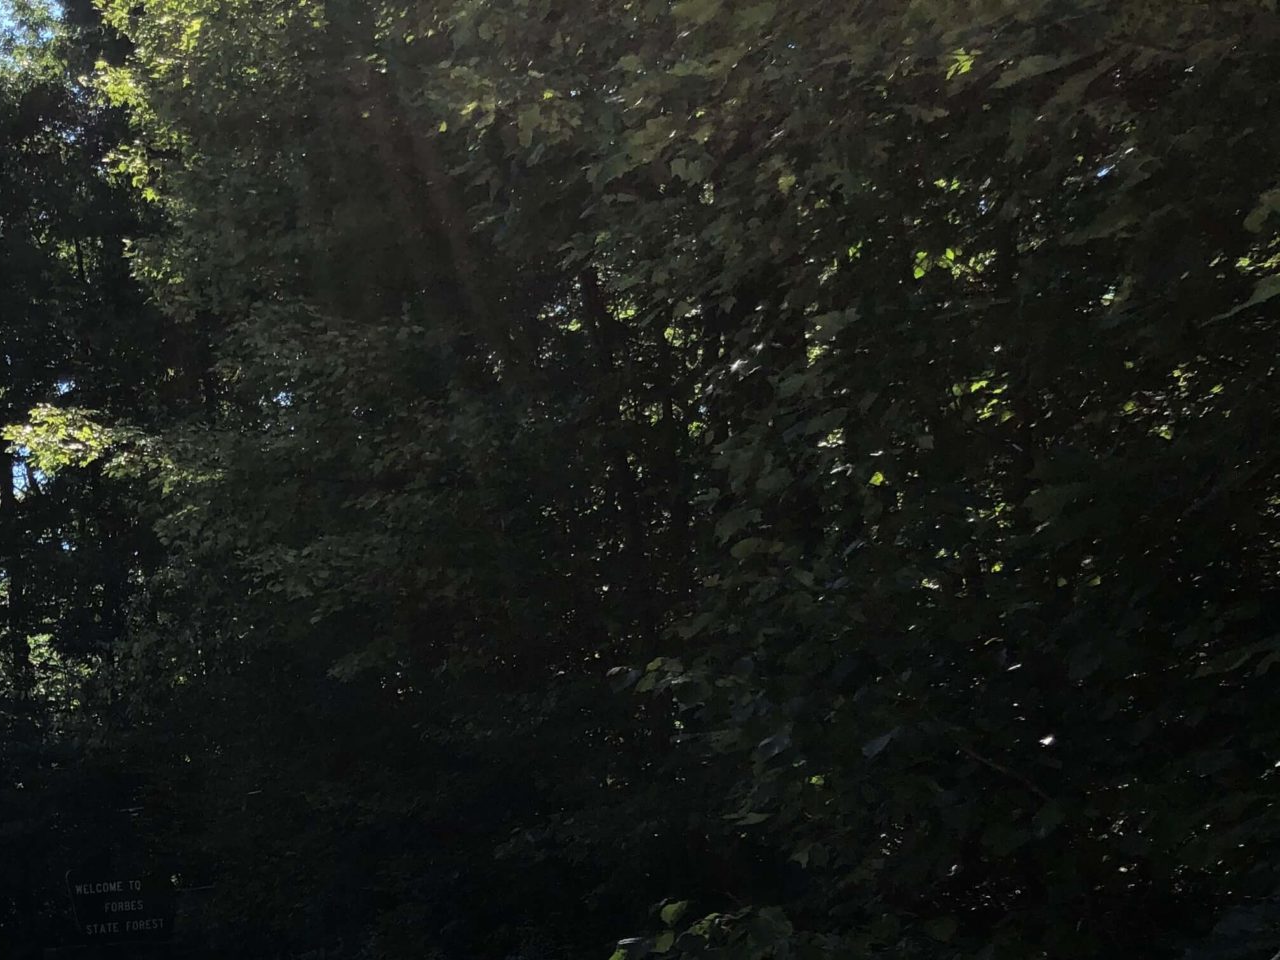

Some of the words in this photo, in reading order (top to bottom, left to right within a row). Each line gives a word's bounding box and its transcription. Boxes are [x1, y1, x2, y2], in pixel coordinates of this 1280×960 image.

[75, 881, 123, 895] WELCOME
[129, 880, 142, 891] TO
[104, 900, 144, 912] FORBES
[86, 922, 120, 935] STATE
[126, 918, 165, 931] FOREST
